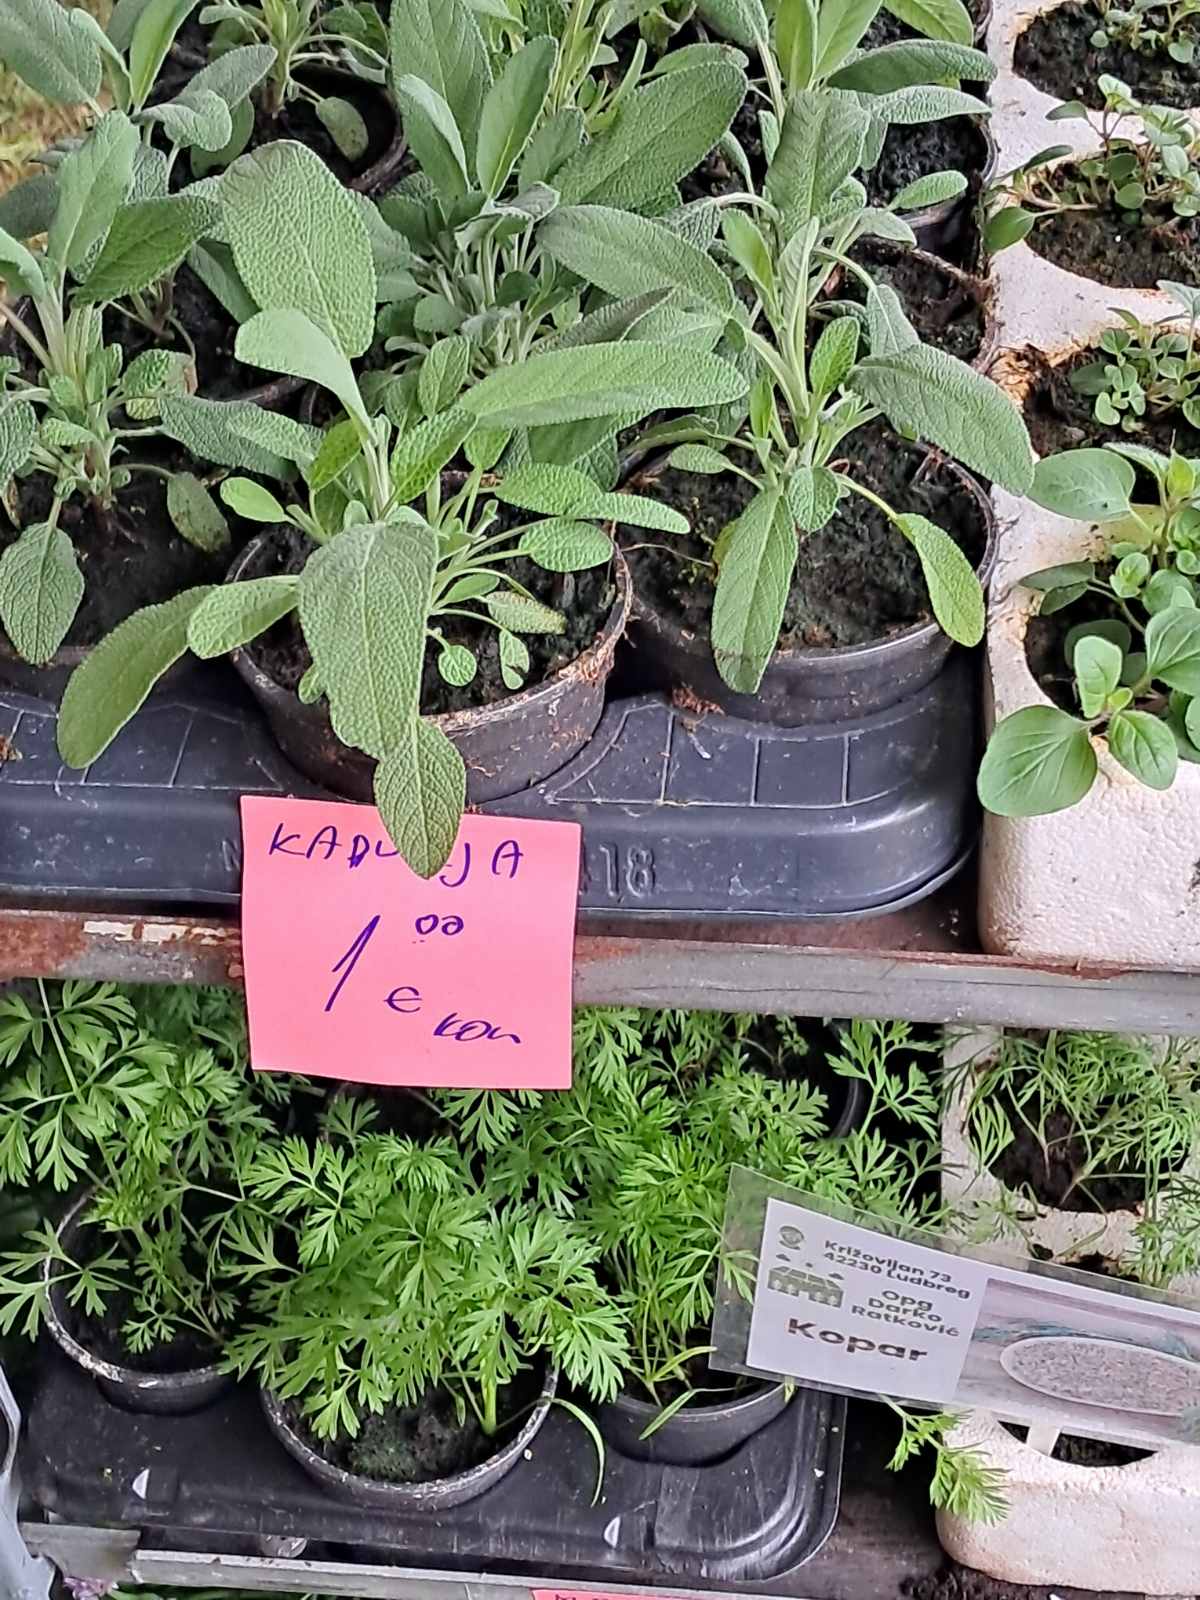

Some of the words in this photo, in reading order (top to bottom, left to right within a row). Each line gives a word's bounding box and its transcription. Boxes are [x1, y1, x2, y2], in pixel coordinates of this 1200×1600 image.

[269, 823, 523, 887] KADUJA
[384, 986, 423, 1013] €
[823, 1252, 882, 1275] 42230
[887, 1269, 971, 1299] Ludbreg
[929, 1270, 952, 1283] 73
[868, 1297, 942, 1322] Darko
[882, 1290, 933, 1312] Opg
[851, 1305, 960, 1337] Ratković
[788, 1318, 928, 1361] Kopar
